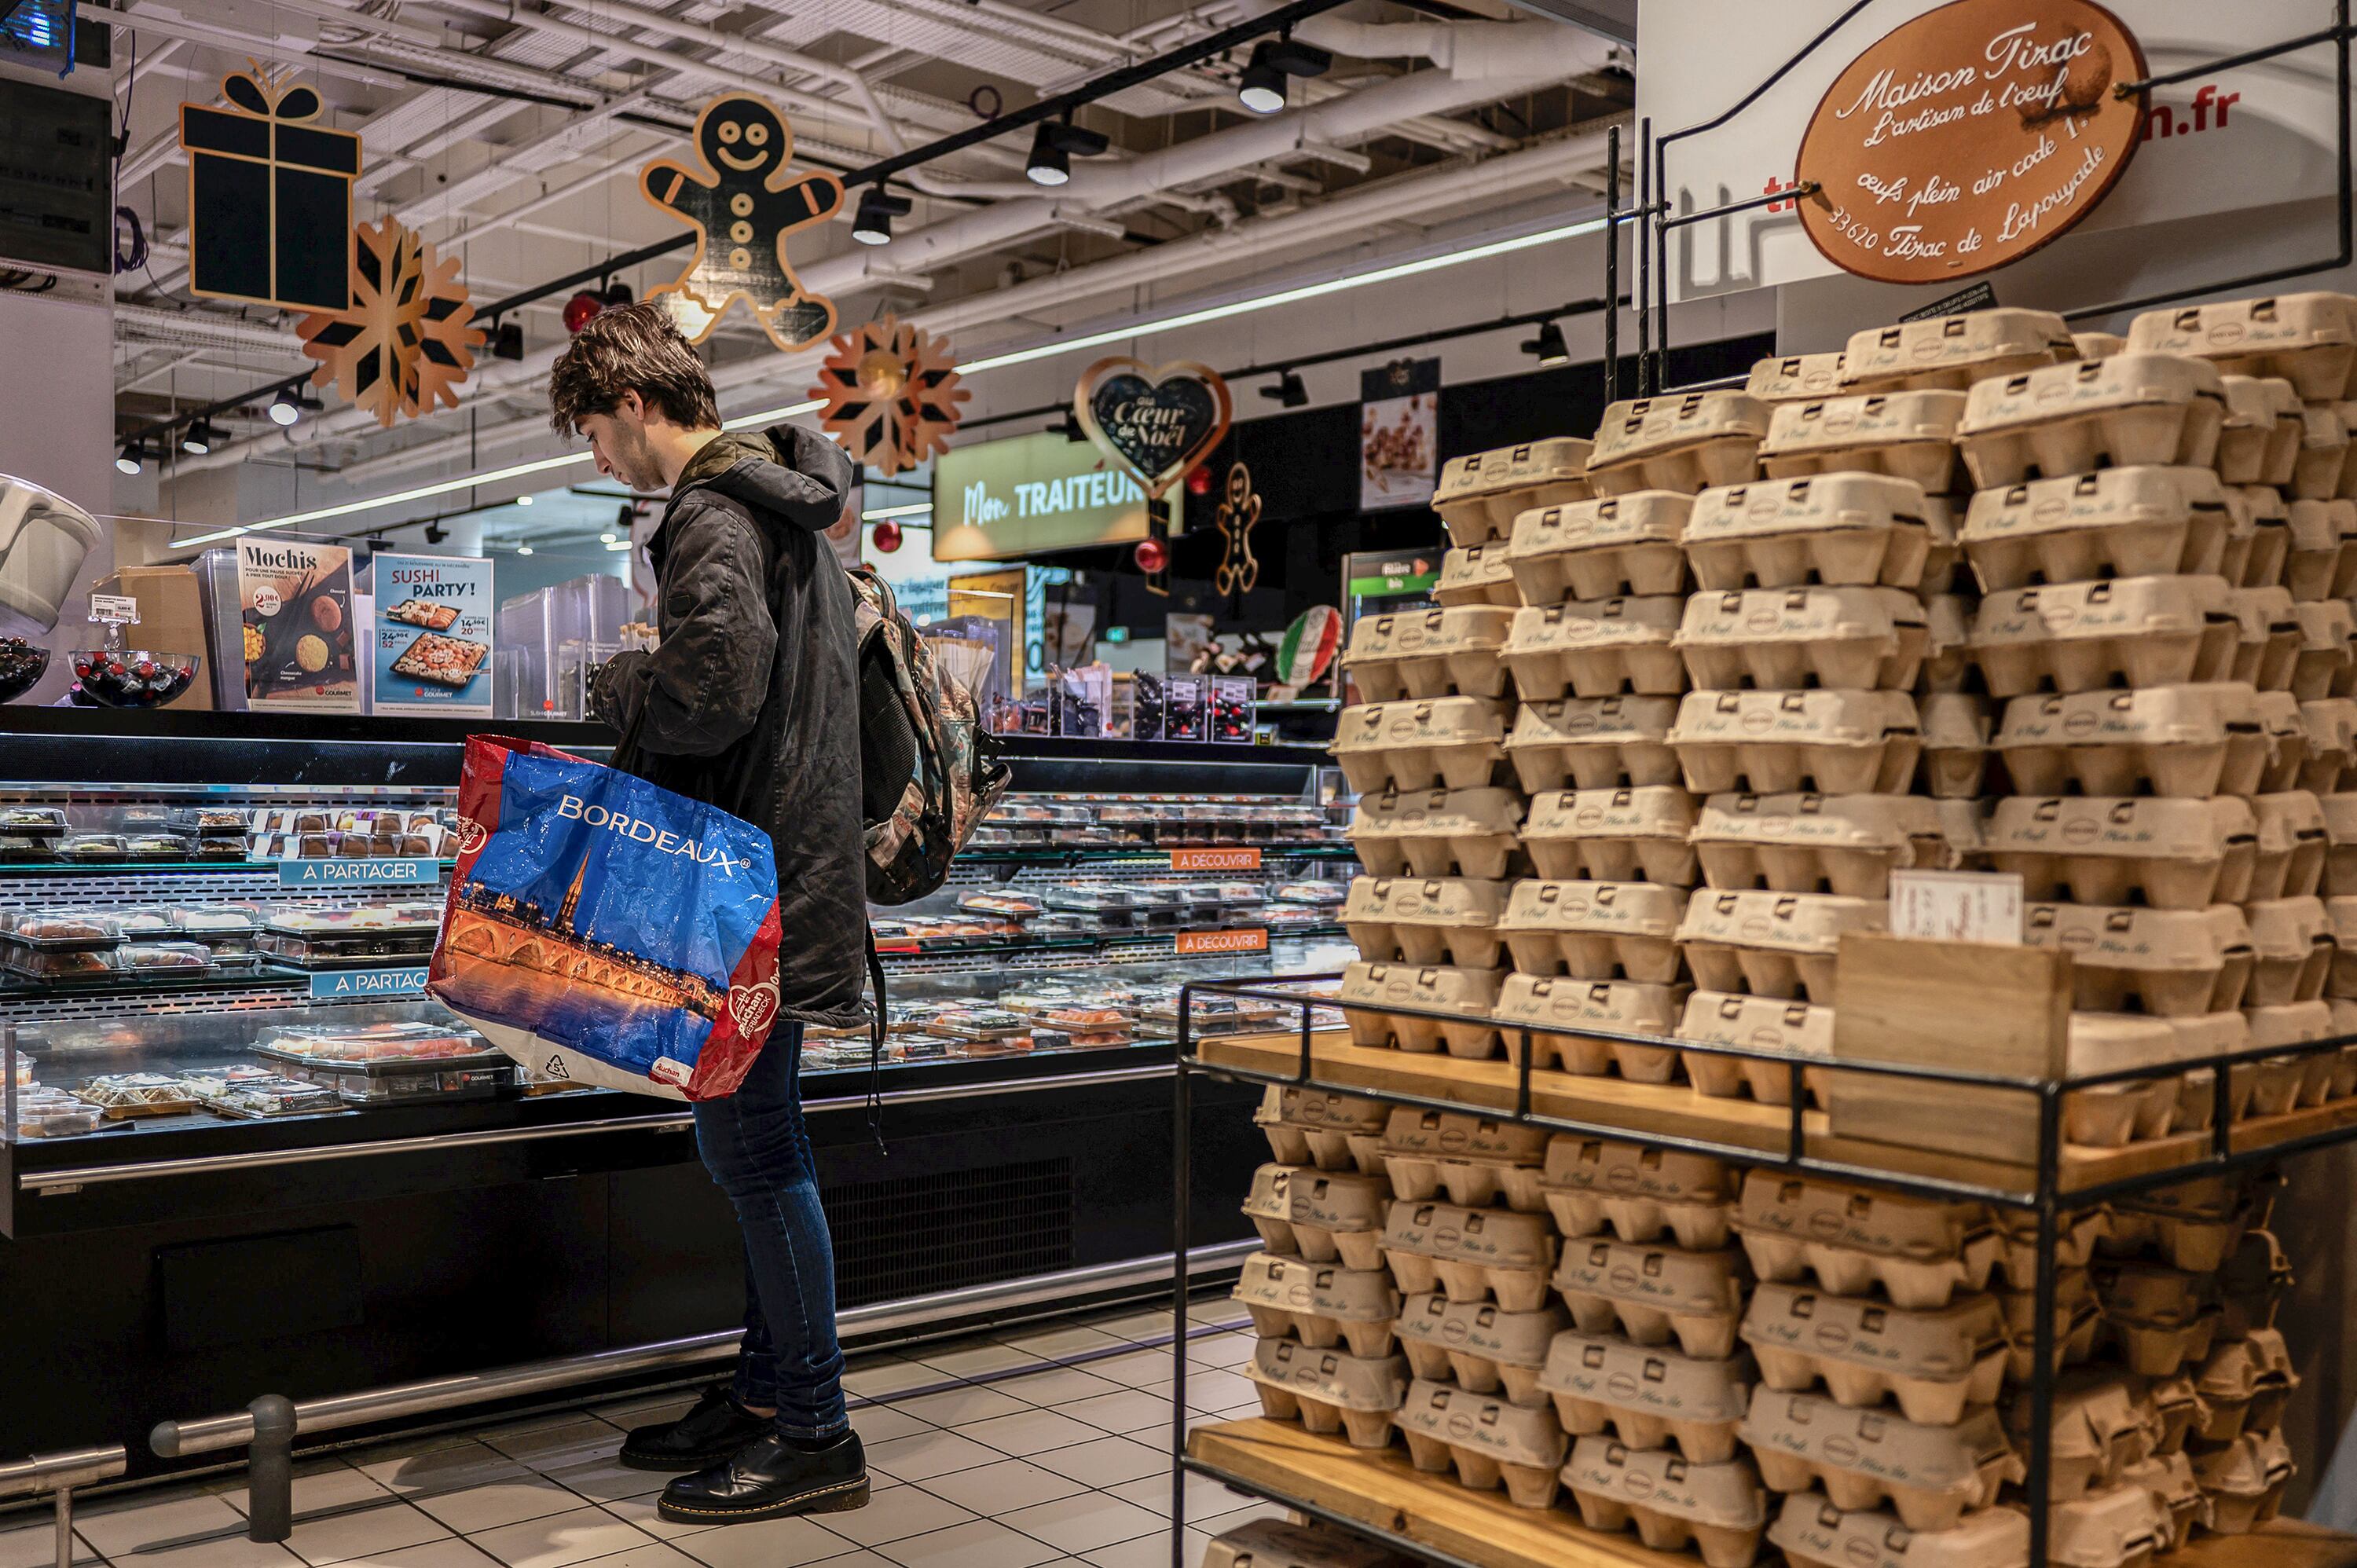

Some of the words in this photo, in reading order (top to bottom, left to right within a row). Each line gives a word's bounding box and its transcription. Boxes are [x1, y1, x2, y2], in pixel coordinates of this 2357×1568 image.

[1835, 67, 1977, 119] Maison
[1864, 110, 1965, 148] L'artisan
[1970, 90, 1993, 115] de
[1907, 175, 1961, 218] plein
[1973, 169, 2007, 196] air
[2011, 135, 2058, 178] code
[1828, 206, 1879, 249] 33620
[1957, 227, 1982, 254] de
[1997, 145, 2107, 243] Lapouyade
[963, 479, 1011, 527] Mon
[245, 546, 317, 570] Mochis
[392, 569, 439, 584] SUSHI
[557, 794, 740, 877] BORDEAUX
[303, 863, 317, 880] A
[324, 863, 417, 880] PARTAGER
[1192, 853, 1252, 867] DÉCOUVRIR
[1197, 934, 1259, 950] DÉCOUVRIR
[335, 976, 350, 992] A
[738, 991, 764, 1037] Auchan
[655, 1062, 680, 1077] Auchan
